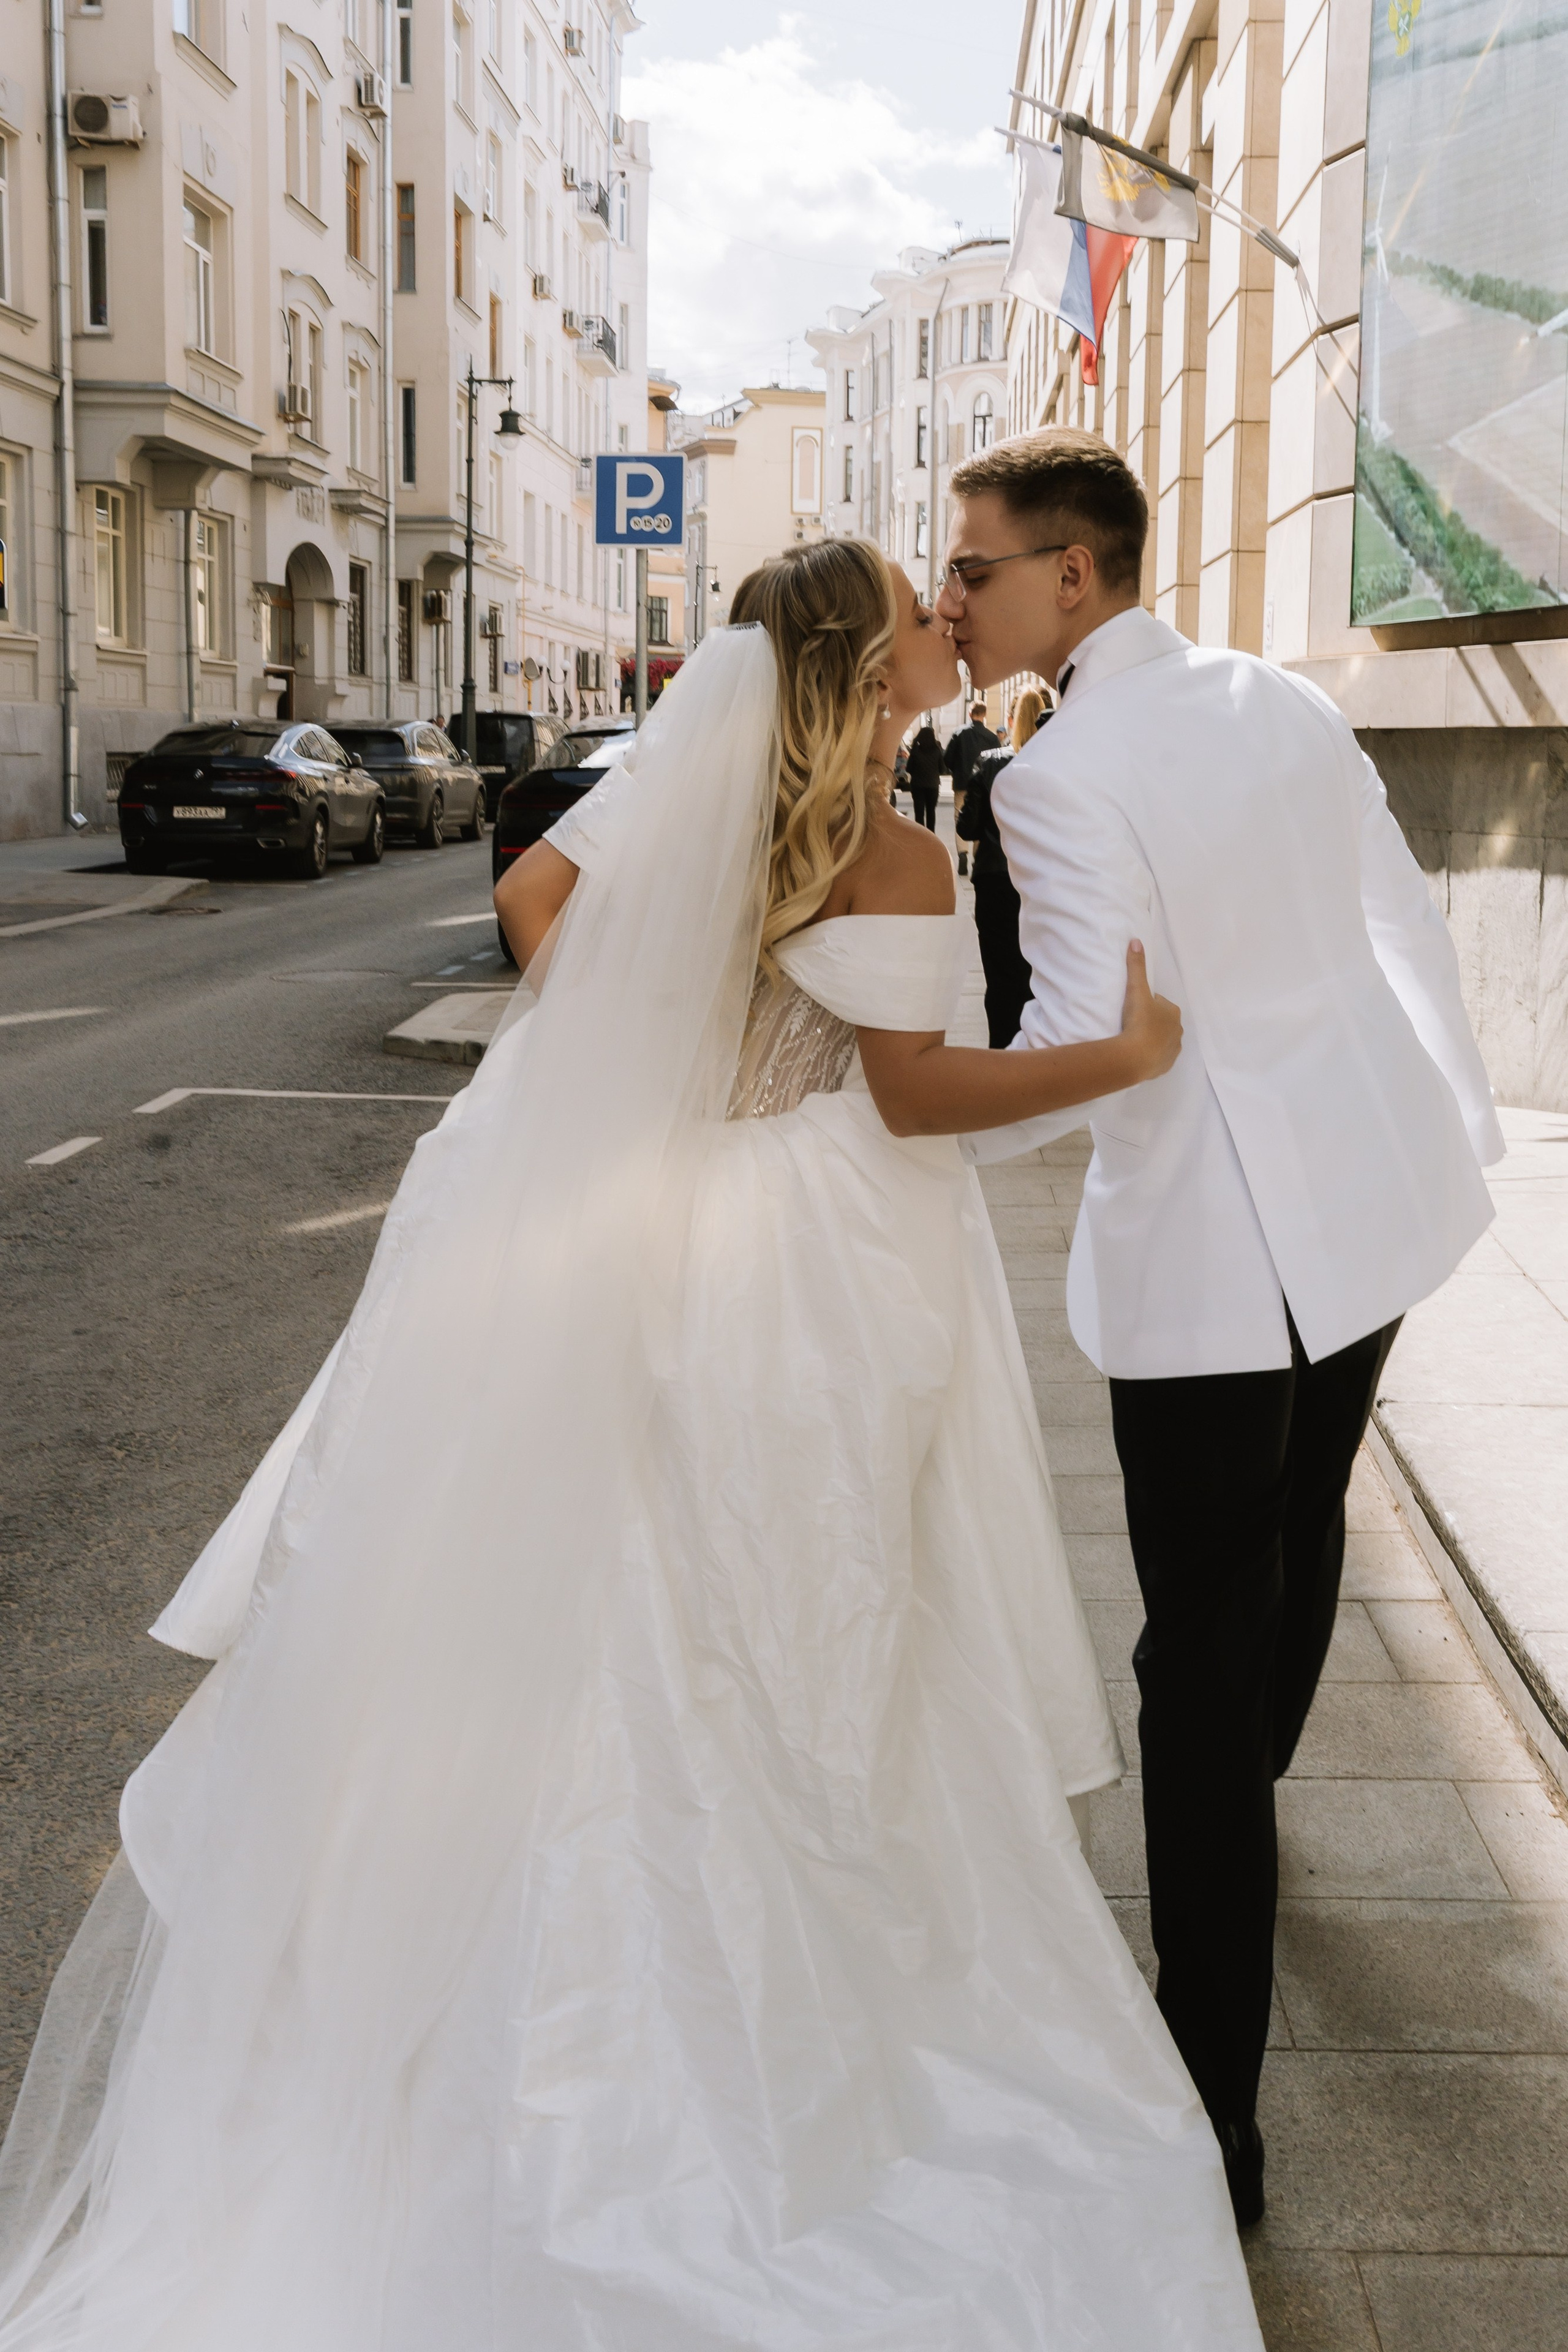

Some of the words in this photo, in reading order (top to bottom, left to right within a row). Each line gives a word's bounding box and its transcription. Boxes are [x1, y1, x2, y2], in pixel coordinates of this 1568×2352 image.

[616, 462, 665, 534] P
[644, 518, 652, 528] 15
[655, 518, 670, 529] 20
